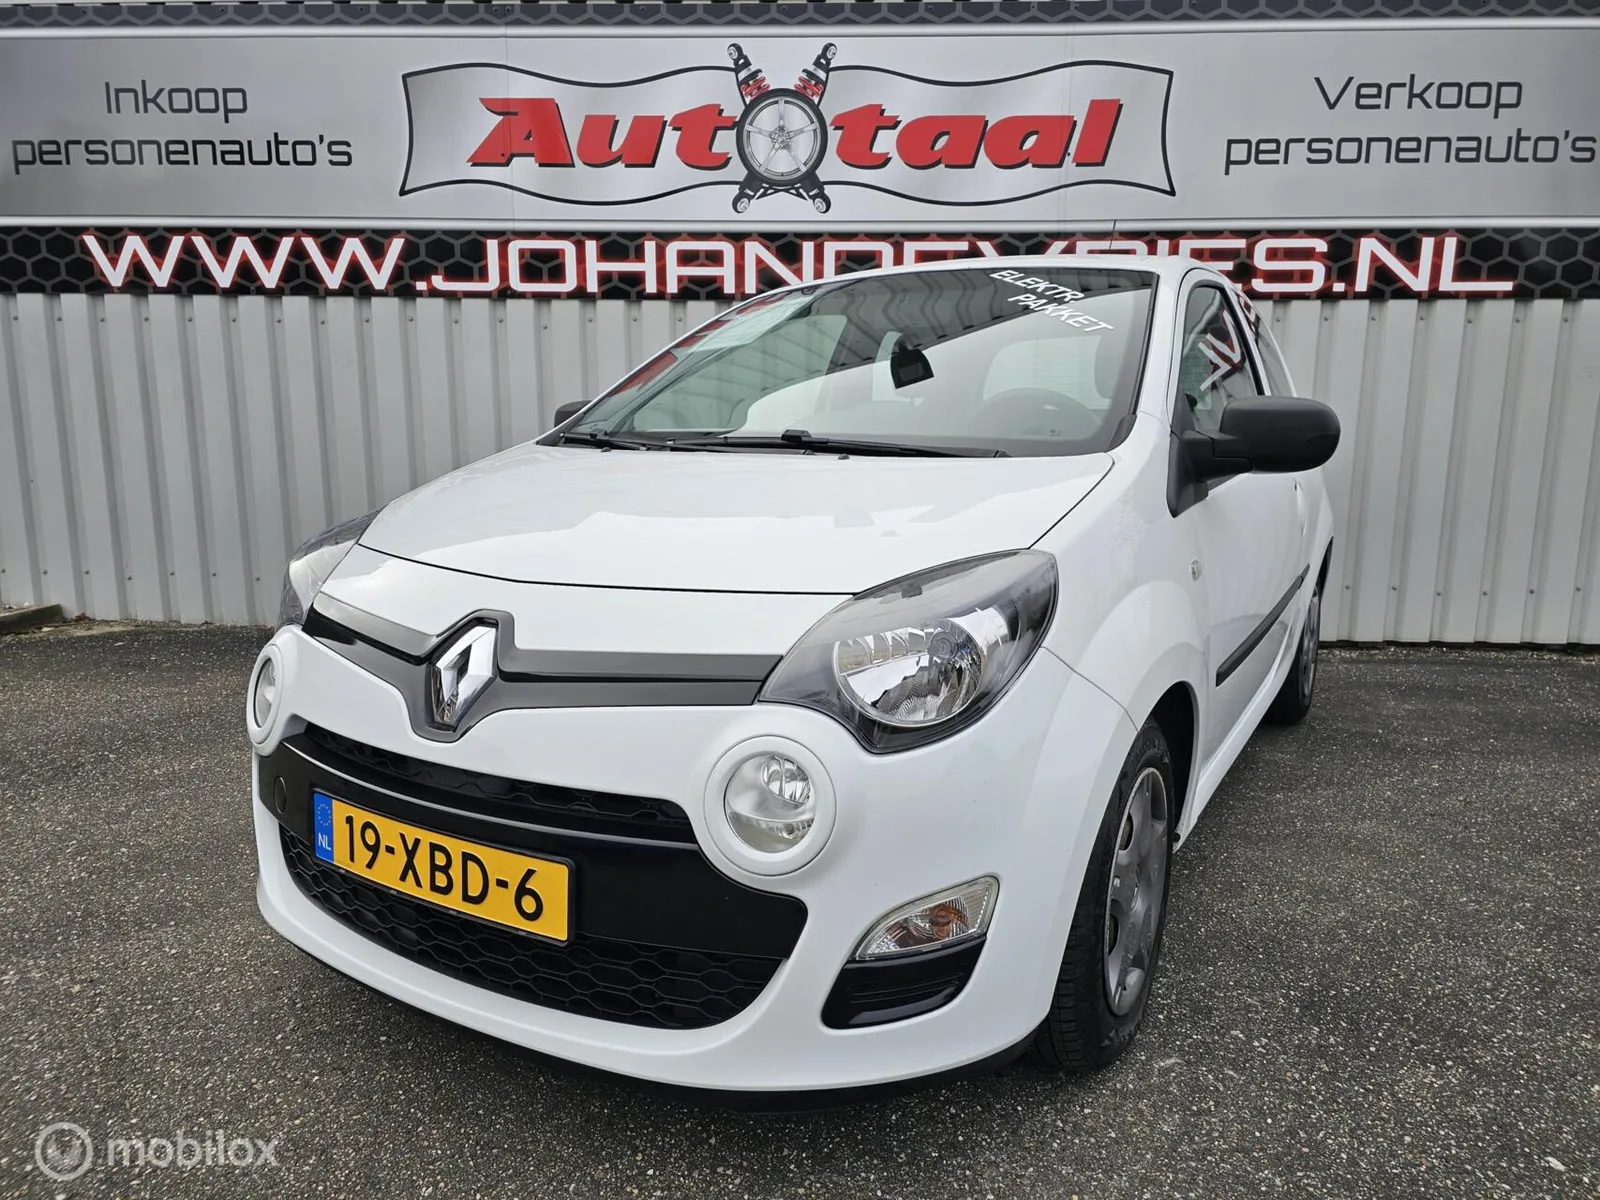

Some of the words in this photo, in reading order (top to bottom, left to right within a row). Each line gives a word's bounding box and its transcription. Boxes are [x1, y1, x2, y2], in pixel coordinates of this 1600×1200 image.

[104, 79, 248, 123] Inkoop
[1314, 74, 1523, 119] Verkoop
[12, 133, 353, 175] personenauto's
[1224, 128, 1597, 175] personenauto's
[989, 269, 1085, 304] ELEKTR.
[1007, 293, 1115, 332] PAKKET
[318, 832, 332, 851] NL
[345, 815, 544, 922] 19-XBD-6
